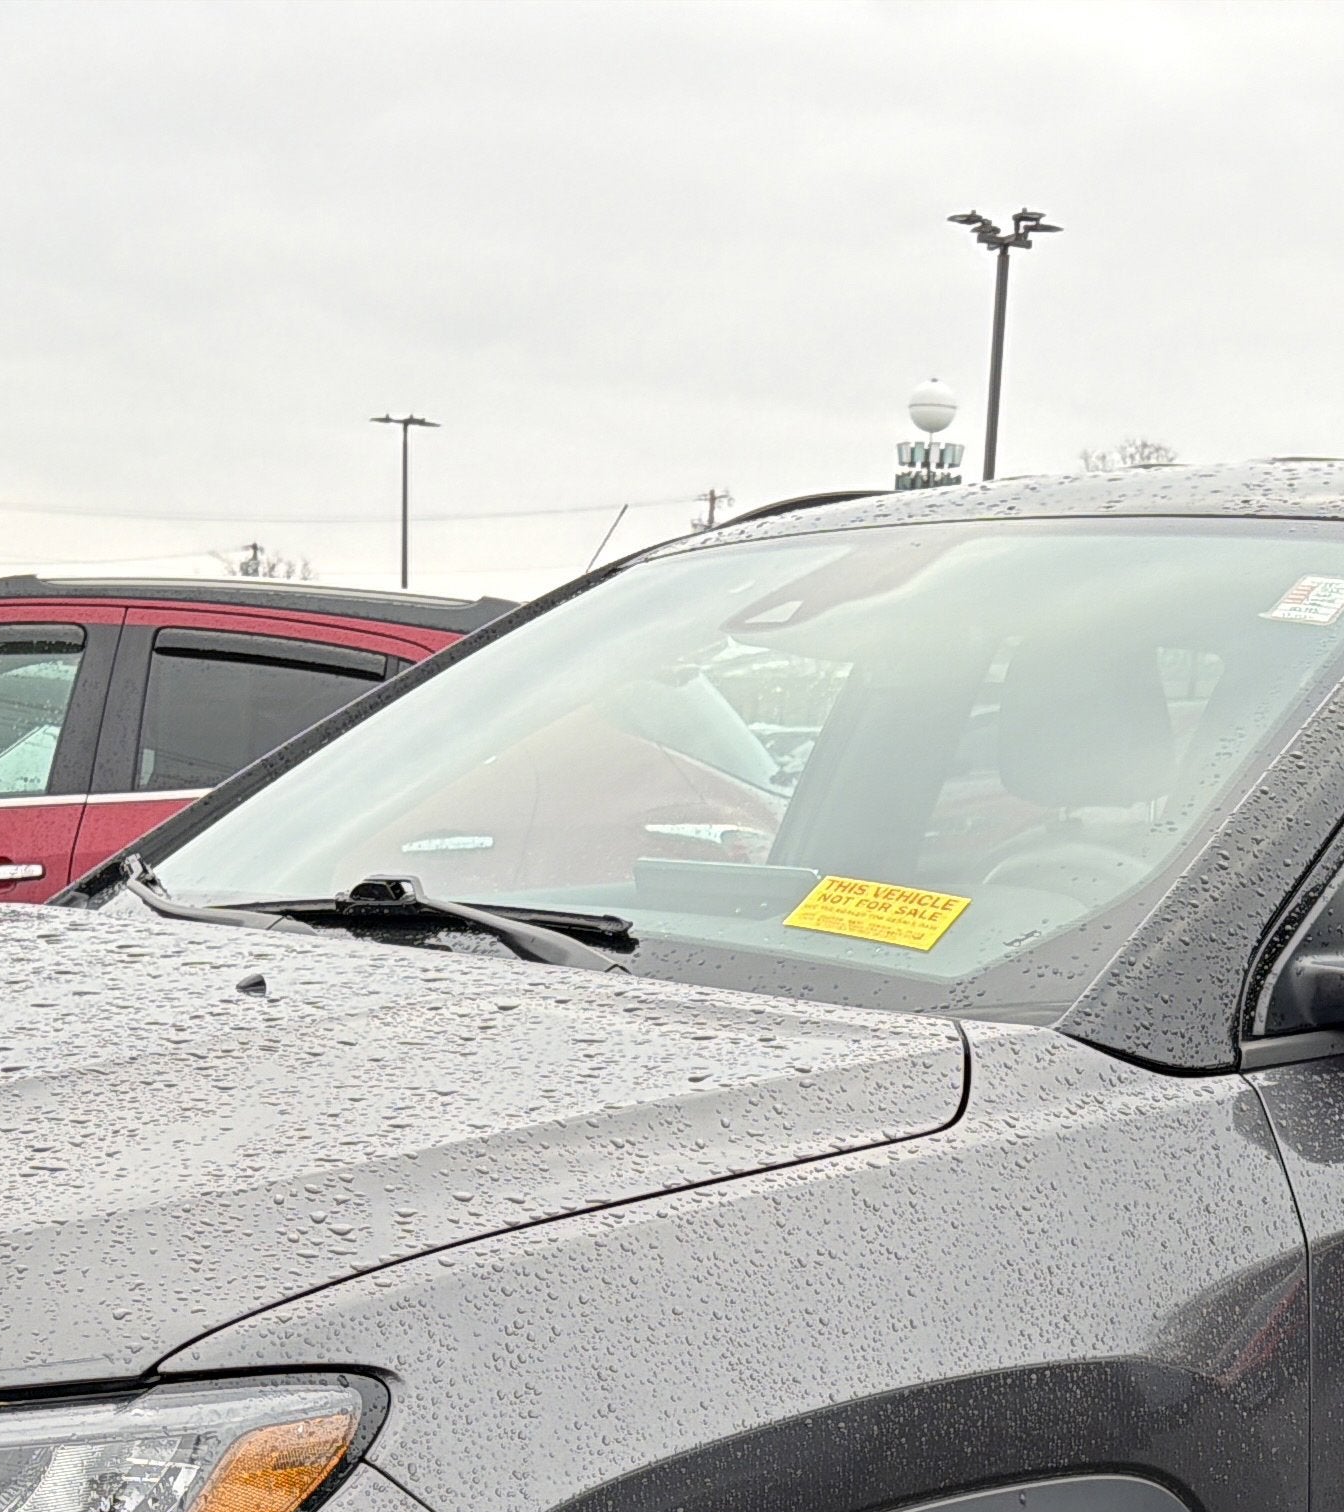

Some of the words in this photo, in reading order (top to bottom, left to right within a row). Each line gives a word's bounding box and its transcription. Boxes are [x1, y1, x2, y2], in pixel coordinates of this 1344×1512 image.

[817, 893, 855, 906] NOT
[855, 898, 893, 913] FOR
[894, 905, 943, 922] SALE
[825, 879, 869, 896] THIS
[873, 886, 959, 912] VEHICLE
